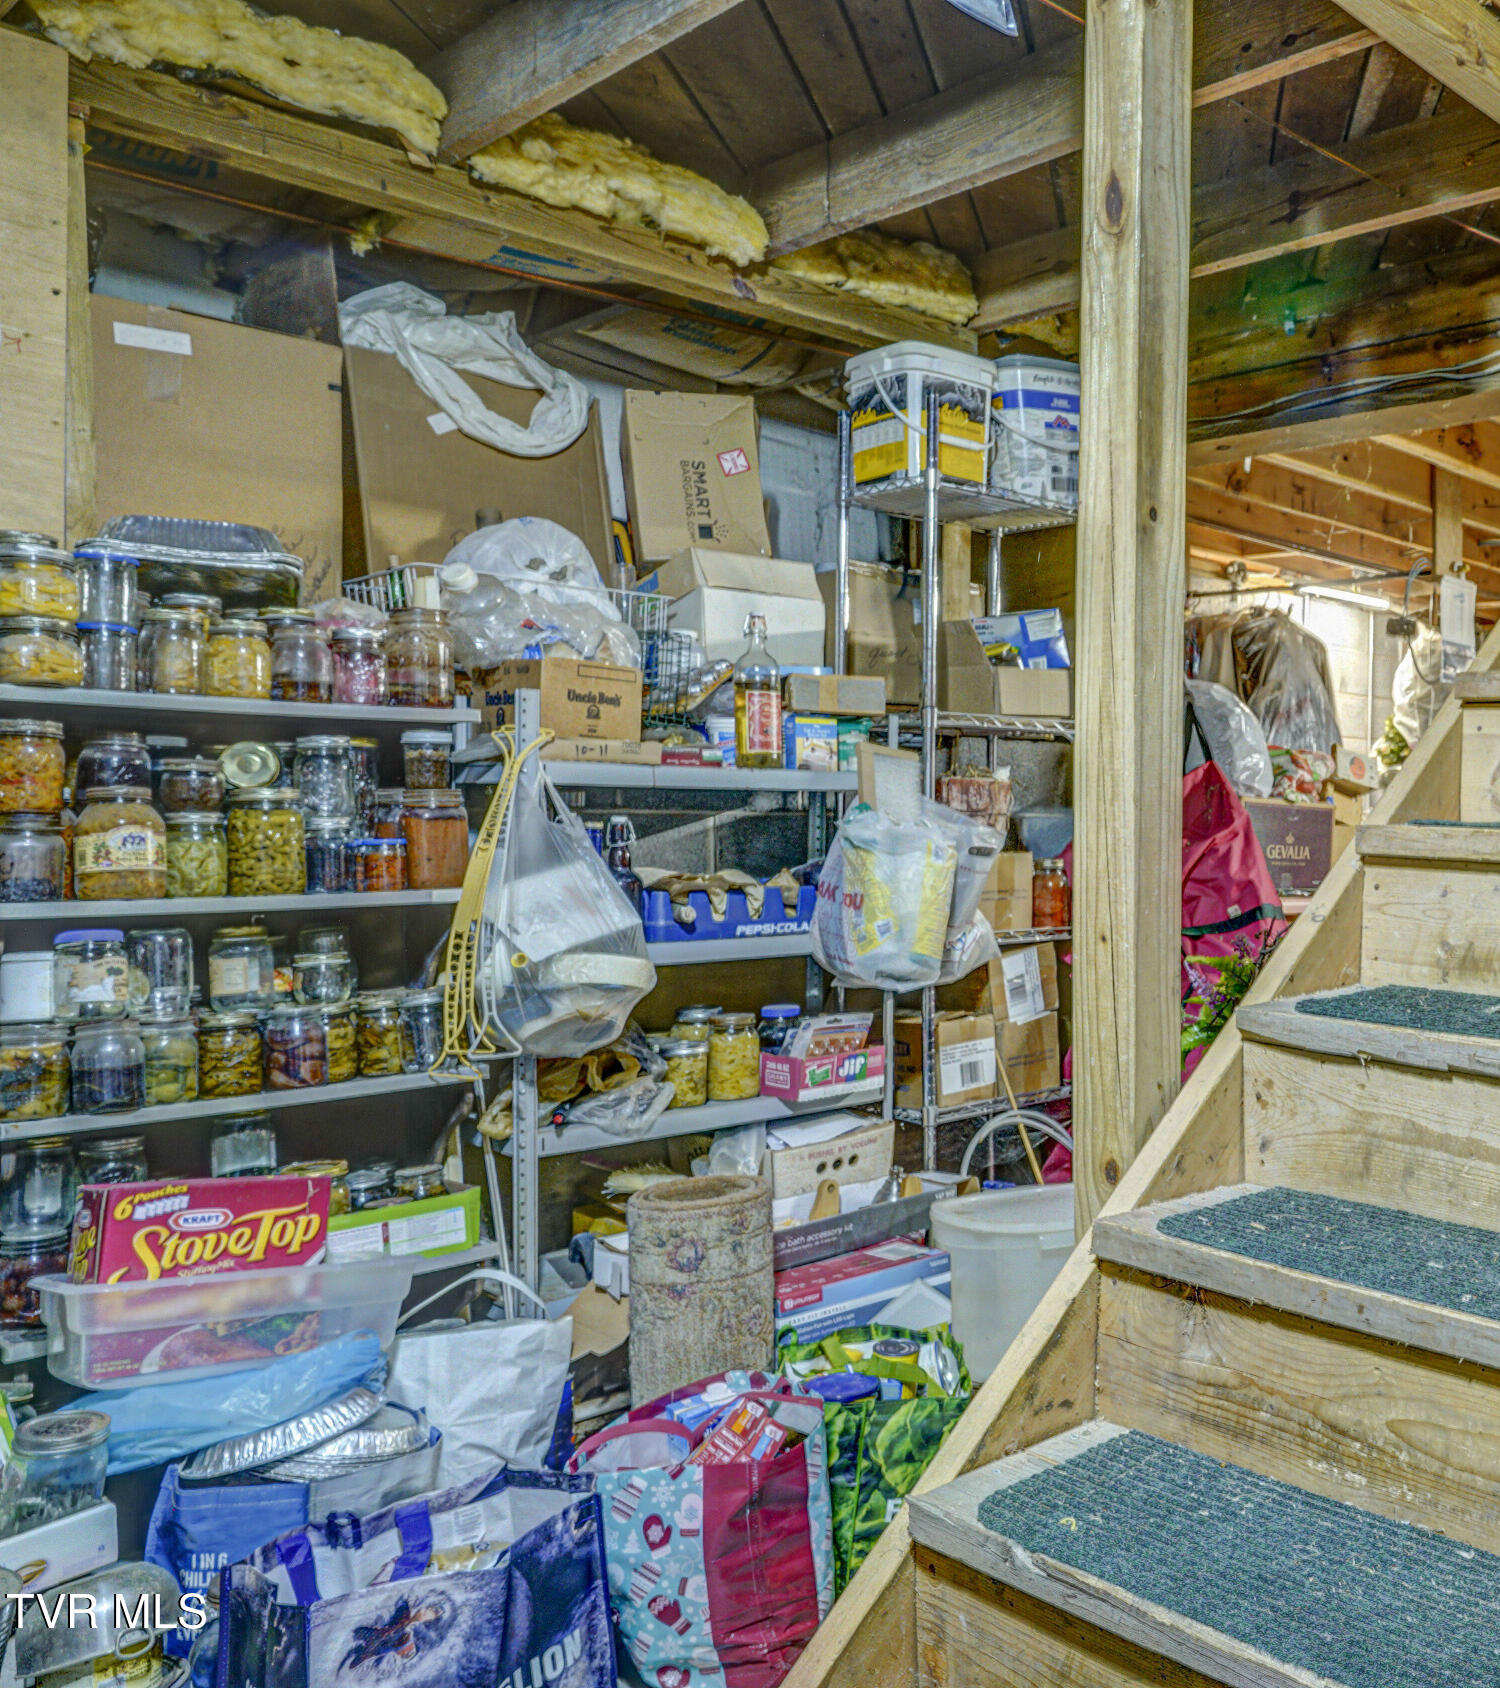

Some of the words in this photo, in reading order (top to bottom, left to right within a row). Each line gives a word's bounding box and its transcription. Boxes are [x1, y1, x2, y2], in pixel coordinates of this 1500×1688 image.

[692, 460, 711, 518] SMART
[681, 460, 696, 542] BARGAINS.COM
[567, 689, 594, 702] Uncle
[1266, 844, 1311, 860] GEVALIA
[736, 920, 810, 936] PEPSI-COLA
[839, 1056, 865, 1077] Jif
[113, 1196, 134, 1221] 6
[133, 1184, 188, 1204] Pouches
[182, 1214, 222, 1225] KRAFT
[499, 1628, 583, 1688] LION
